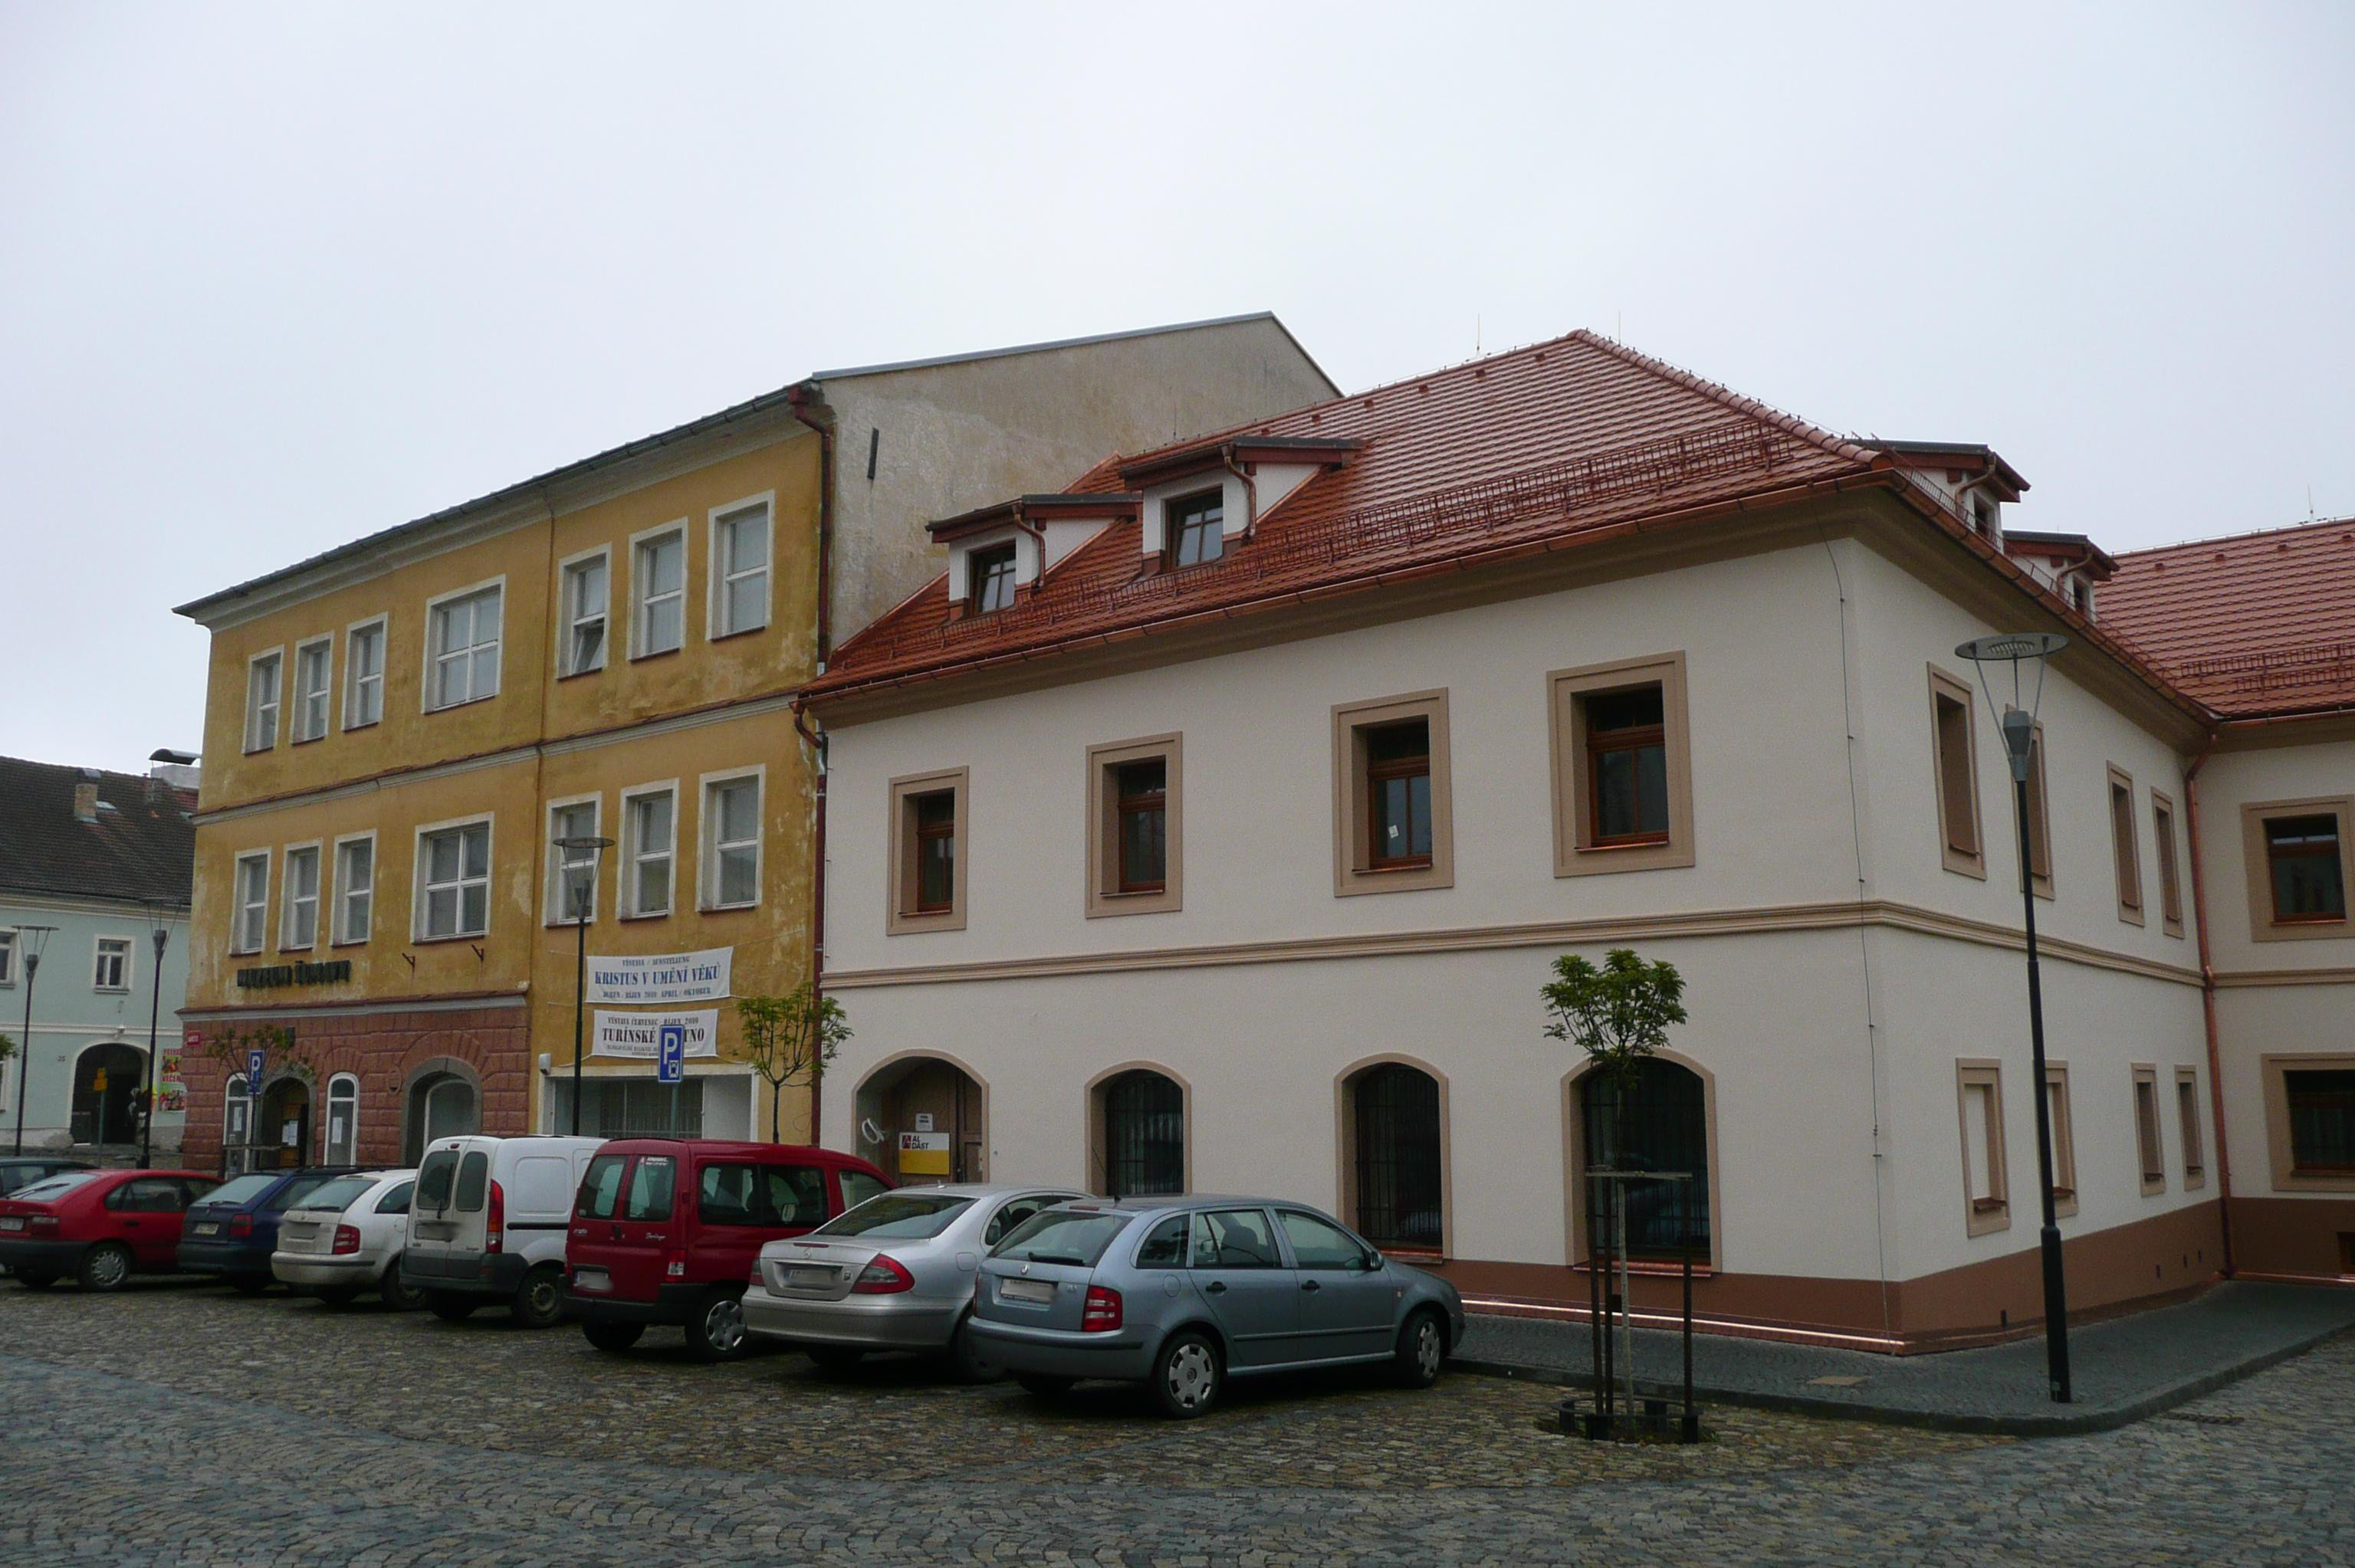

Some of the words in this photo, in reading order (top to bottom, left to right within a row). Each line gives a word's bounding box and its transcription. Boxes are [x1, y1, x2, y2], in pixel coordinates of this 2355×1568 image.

[652, 956, 690, 966] AUSSTELLUNG
[237, 966, 293, 987] MUZEUM
[595, 971, 639, 986] KRISTUS
[642, 972, 649, 986] V
[652, 966, 688, 985] UMĚNÍ
[691, 962, 721, 982] VĚKŮ
[683, 986, 711, 996] OKTOBER
[602, 1025, 656, 1043] TURÍNSKÉ
[664, 1032, 678, 1064] P
[251, 1055, 261, 1081] P
